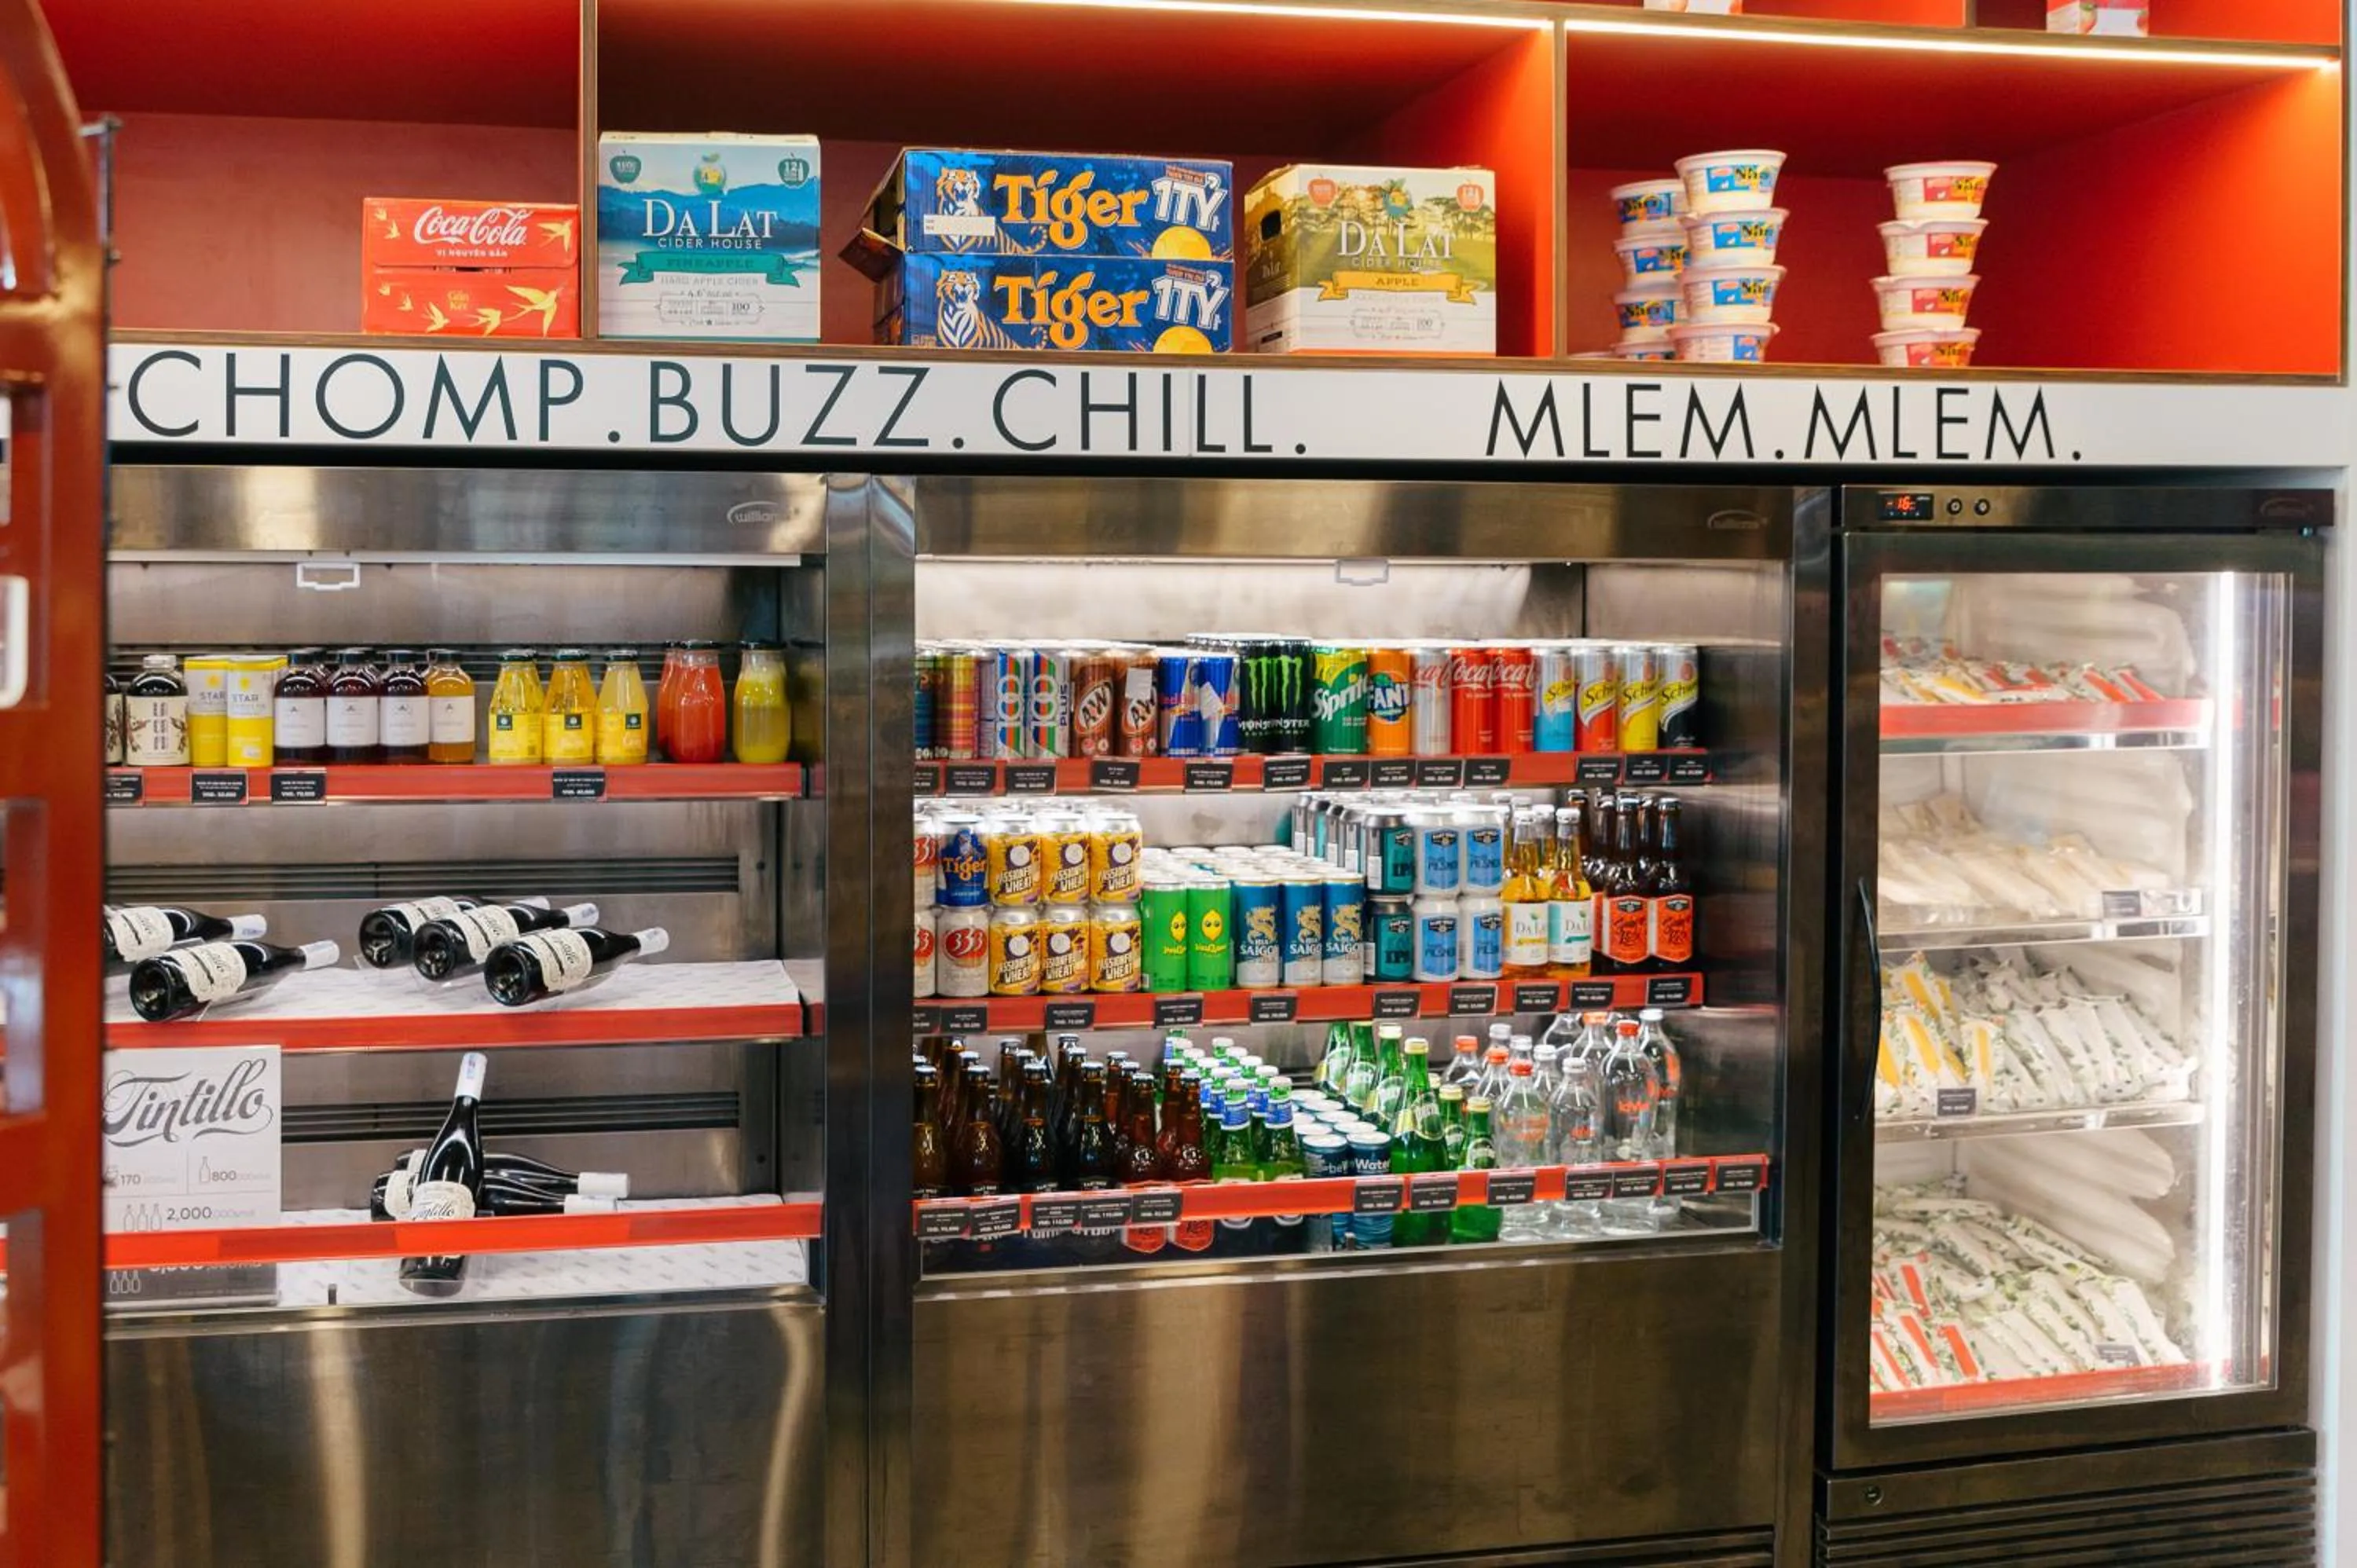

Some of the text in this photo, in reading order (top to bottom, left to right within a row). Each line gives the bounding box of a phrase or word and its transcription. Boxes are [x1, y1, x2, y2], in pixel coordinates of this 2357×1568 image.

[993, 170, 1149, 249] Tiger
[413, 205, 534, 247] Coca-Cola
[708, 199, 779, 239] LAT
[658, 238, 763, 251] CIDER HOUSE
[666, 258, 754, 269] PINEAPPLE
[1376, 277, 1420, 288] APPLE
[994, 270, 1149, 349] Tiger
[943, 855, 987, 881] Tiger
[1006, 875, 1032, 893] WHEAT
[1061, 874, 1086, 892] WHEAT
[1107, 873, 1135, 891] WHEAT
[1004, 966, 1032, 984] WHEAT
[1046, 964, 1073, 980] WHEAT
[1105, 962, 1134, 980] WHEAT
[103, 1057, 274, 1148] Tintillo
